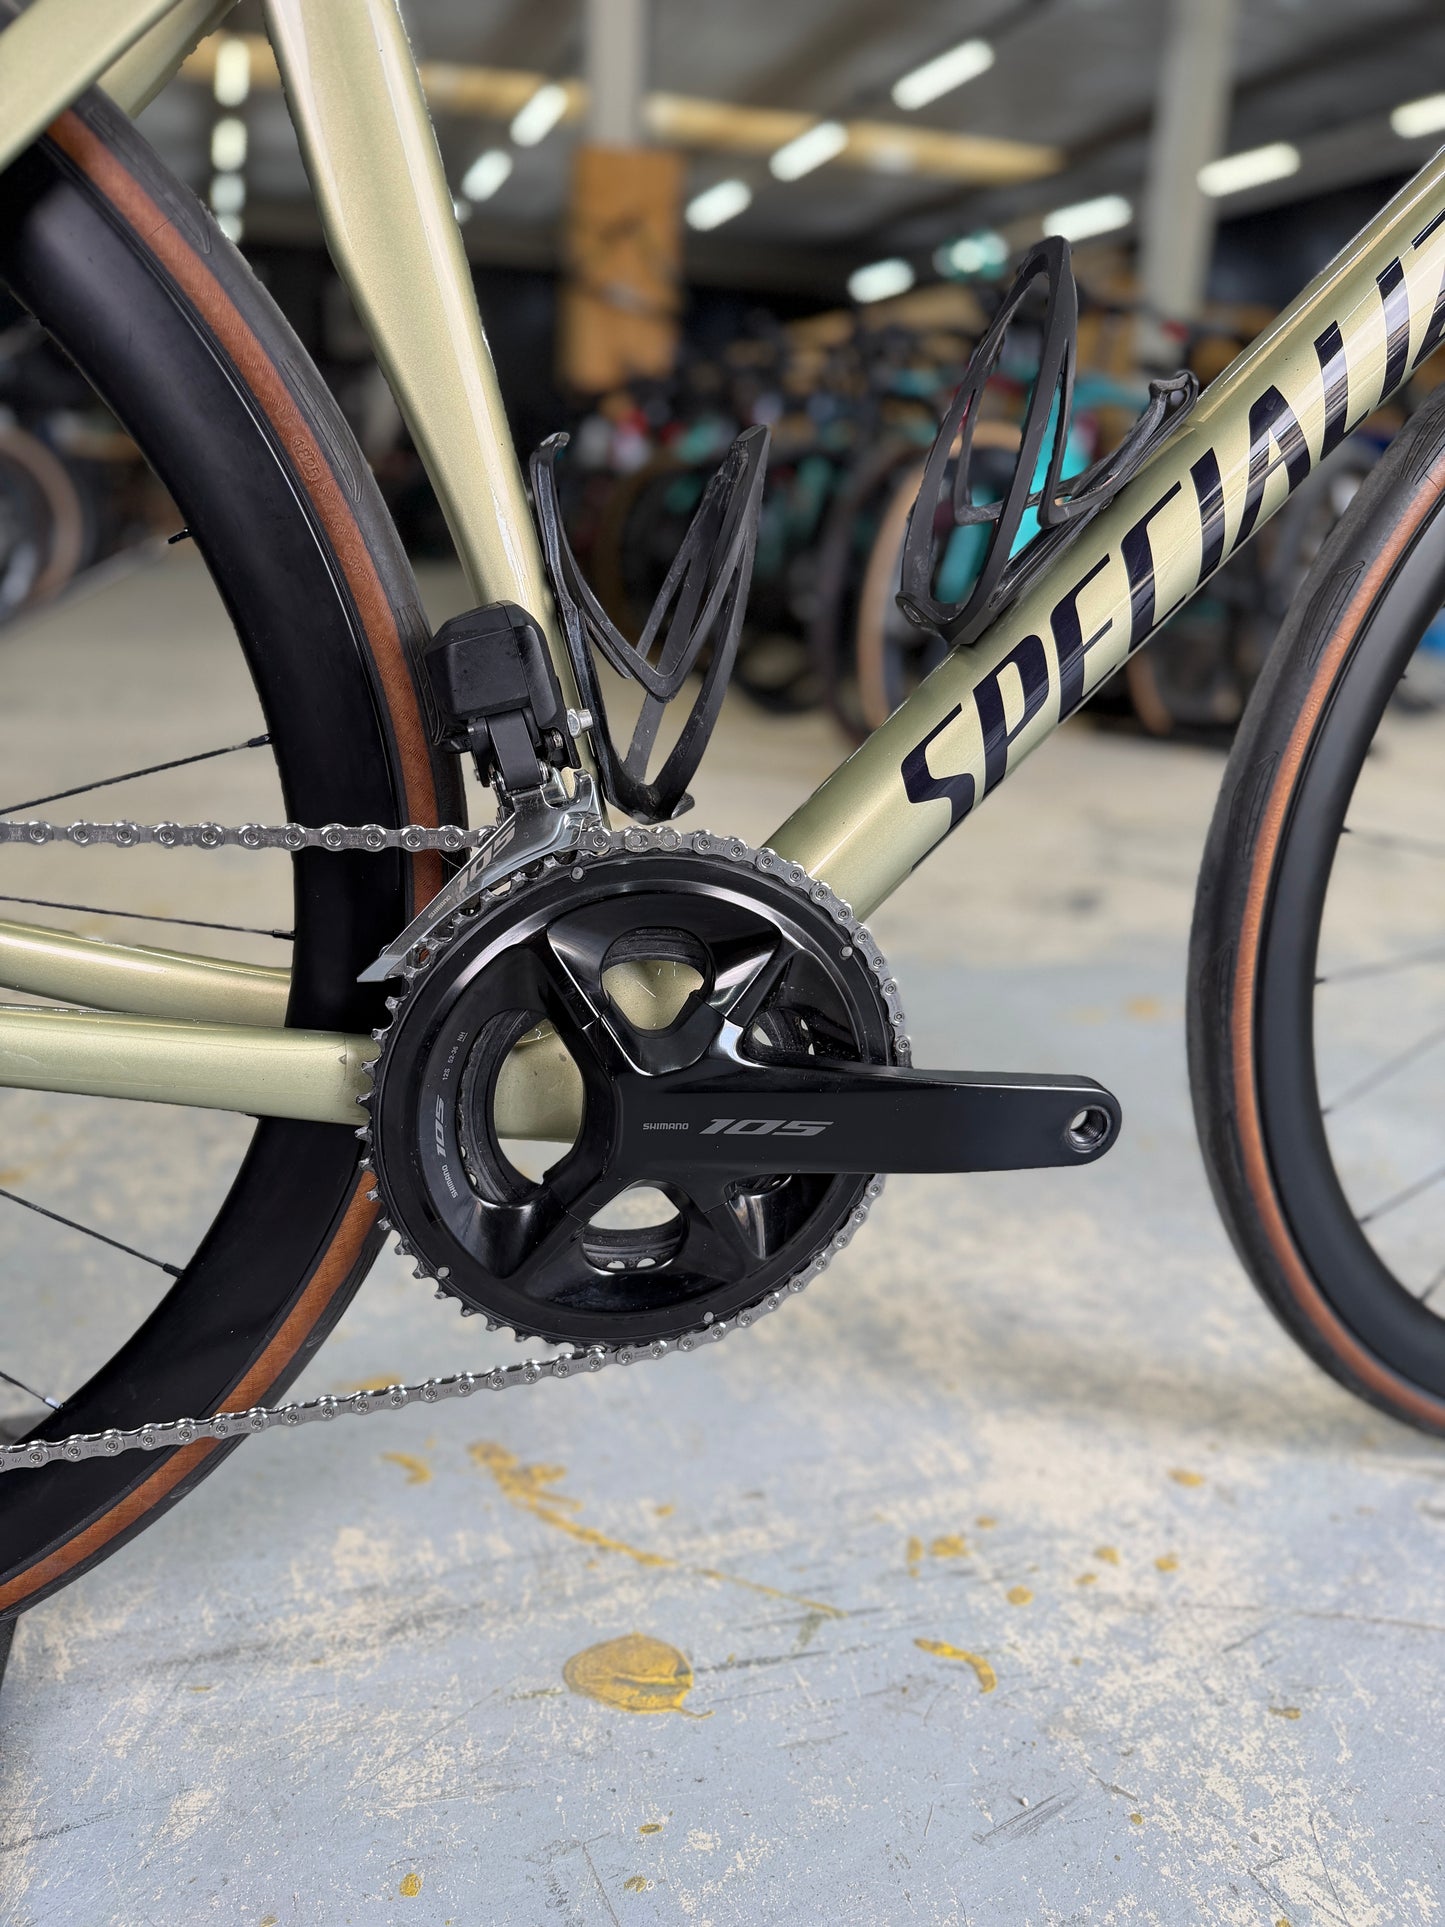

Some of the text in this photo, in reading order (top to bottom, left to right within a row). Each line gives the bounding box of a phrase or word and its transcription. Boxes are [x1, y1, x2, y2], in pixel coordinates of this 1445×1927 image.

[457, 821, 516, 894] 105
[435, 1094, 459, 1199] SHIMANO 105
[642, 1118, 835, 1137] SHIMANO 105
